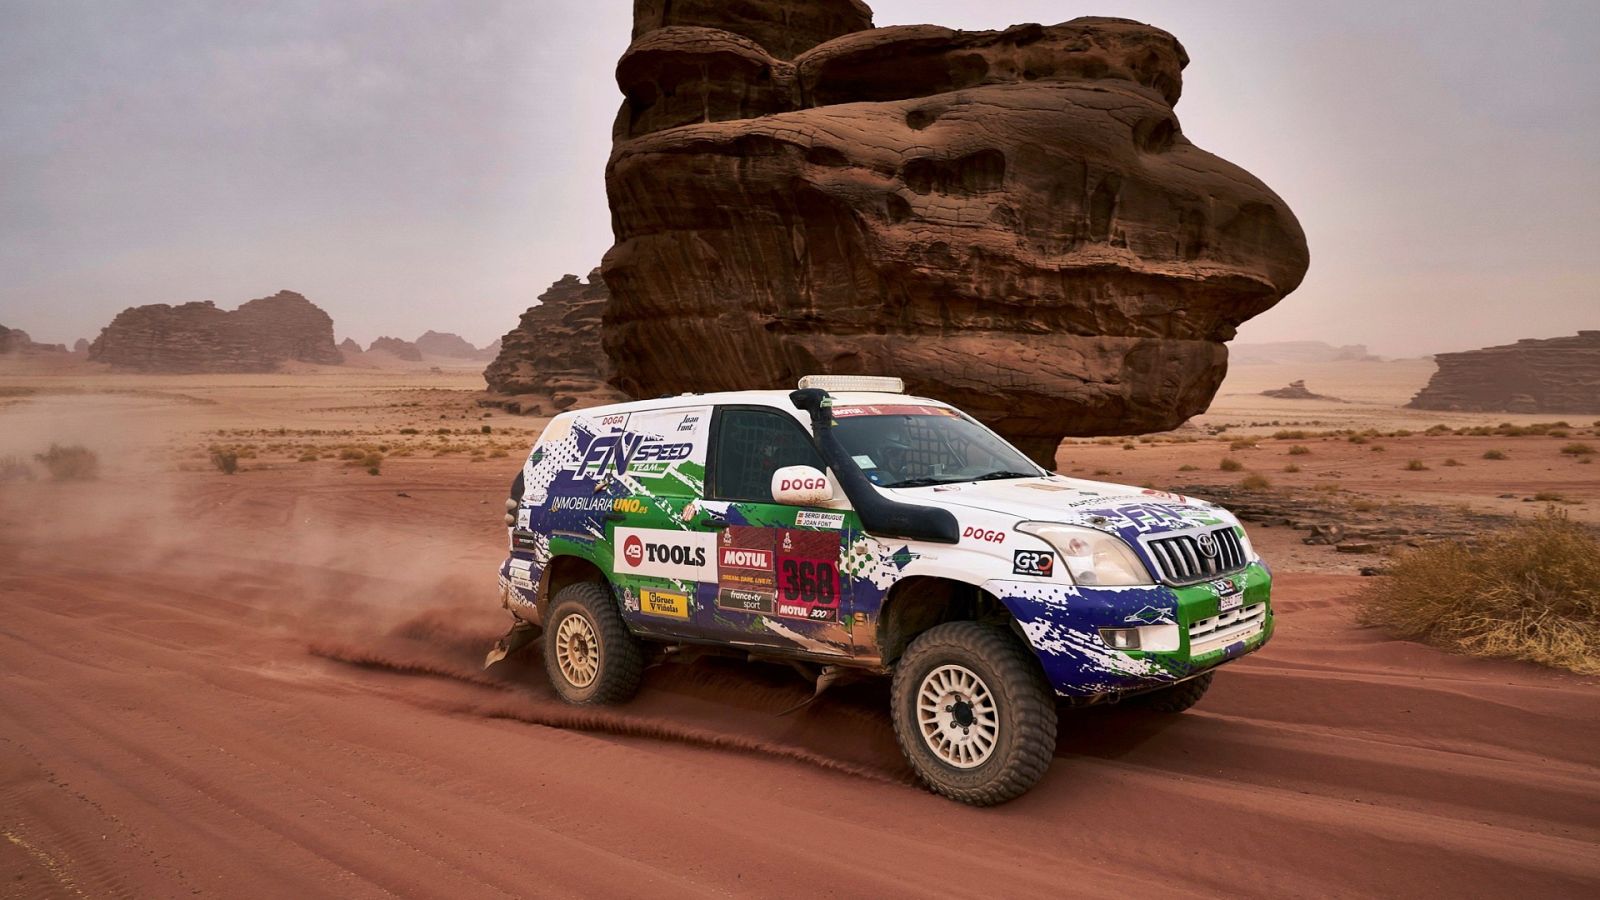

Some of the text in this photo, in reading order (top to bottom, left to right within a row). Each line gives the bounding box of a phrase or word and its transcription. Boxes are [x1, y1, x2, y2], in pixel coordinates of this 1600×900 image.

[602, 416, 624, 425] DOGA
[632, 443, 693, 461] SPEED
[781, 477, 826, 491] DOGA
[963, 526, 1006, 544] DOGA
[646, 543, 705, 567] TOOLS
[724, 551, 767, 568] MOTUL
[1015, 552, 1053, 571] GRO
[783, 560, 834, 604] 368
[743, 601, 760, 610] sport
[780, 604, 808, 617] MOTUL
